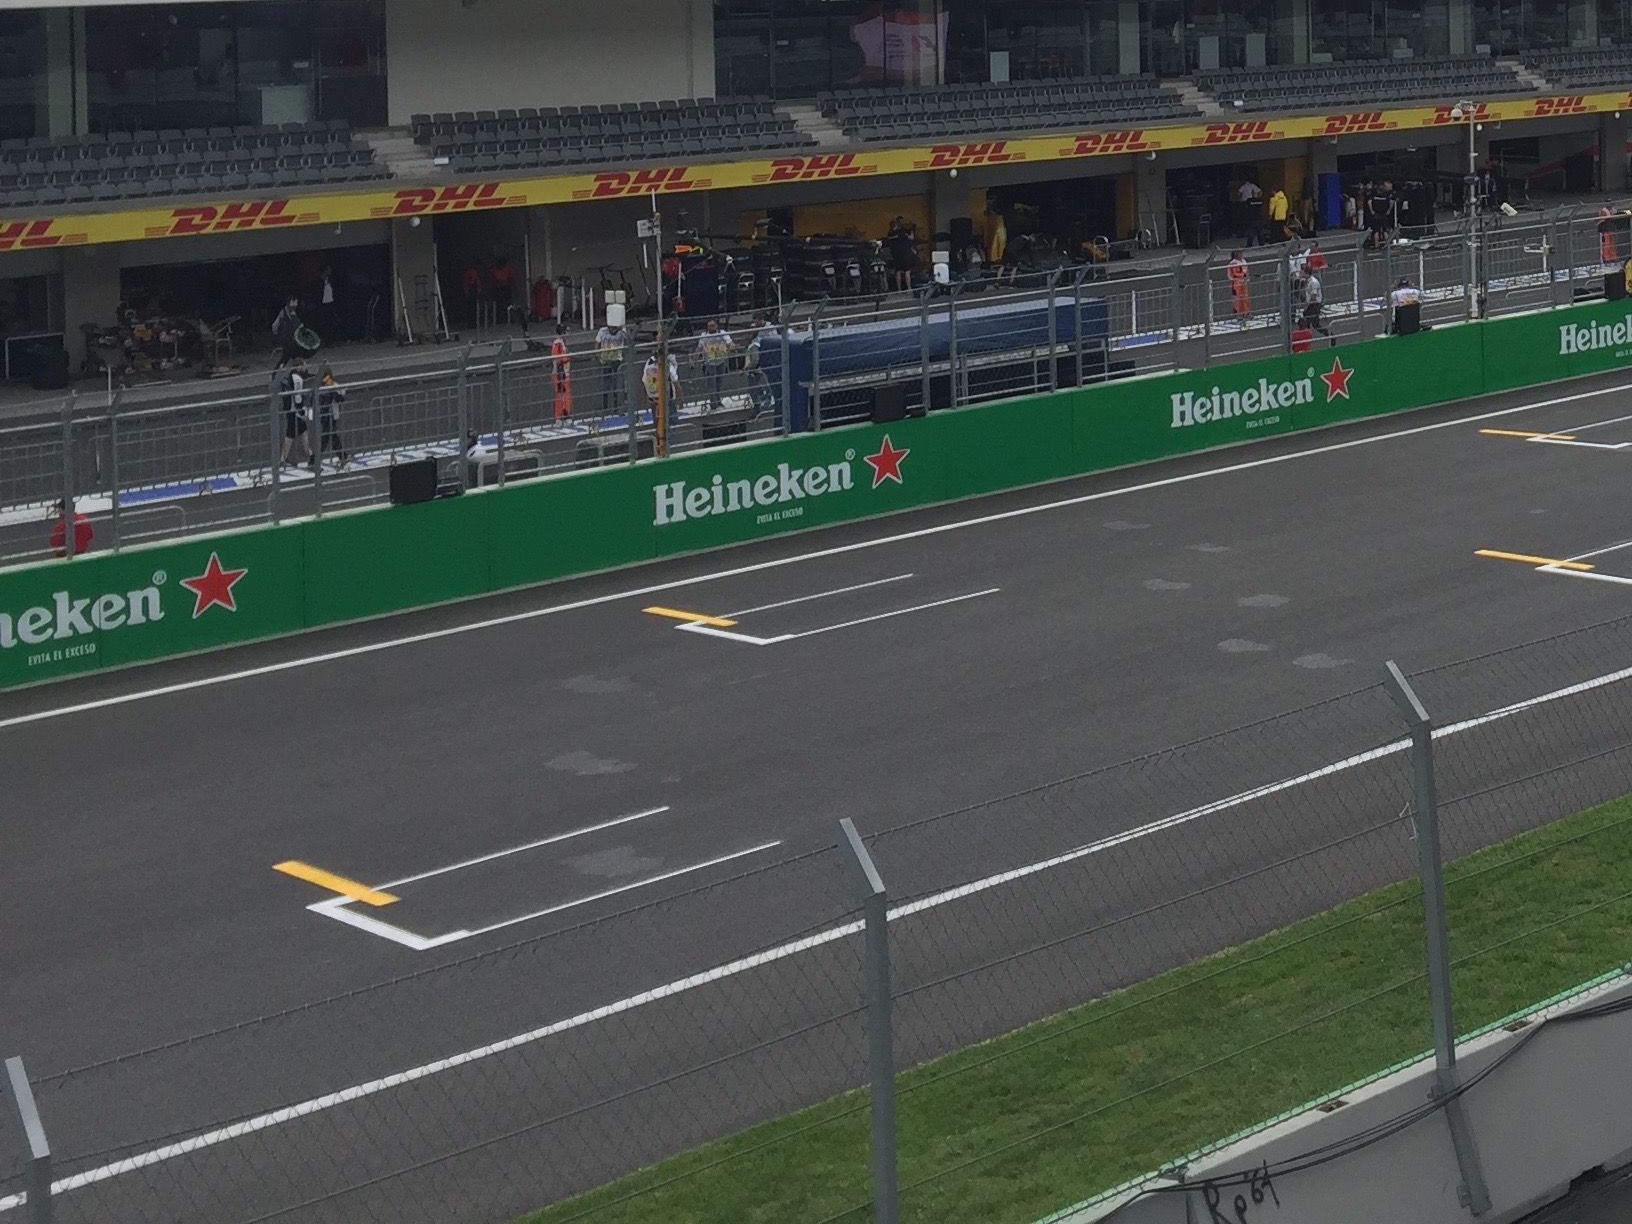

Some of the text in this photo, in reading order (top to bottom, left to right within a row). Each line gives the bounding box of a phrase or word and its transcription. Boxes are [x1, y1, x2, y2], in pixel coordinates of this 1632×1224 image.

[1533, 96, 1587, 116] DHL
[1204, 121, 1274, 144] DHL
[1322, 111, 1387, 135] DHL
[928, 141, 1014, 167] DHL
[1072, 130, 1149, 154] DHL
[768, 153, 864, 181] DHL
[592, 168, 695, 197] DHL
[394, 182, 508, 214] DHL
[169, 200, 298, 234] DHL
[1170, 378, 1313, 428] Heineken
[653, 463, 854, 526] Heineken
[28, 643, 97, 666] EVITA EL EXCESO
